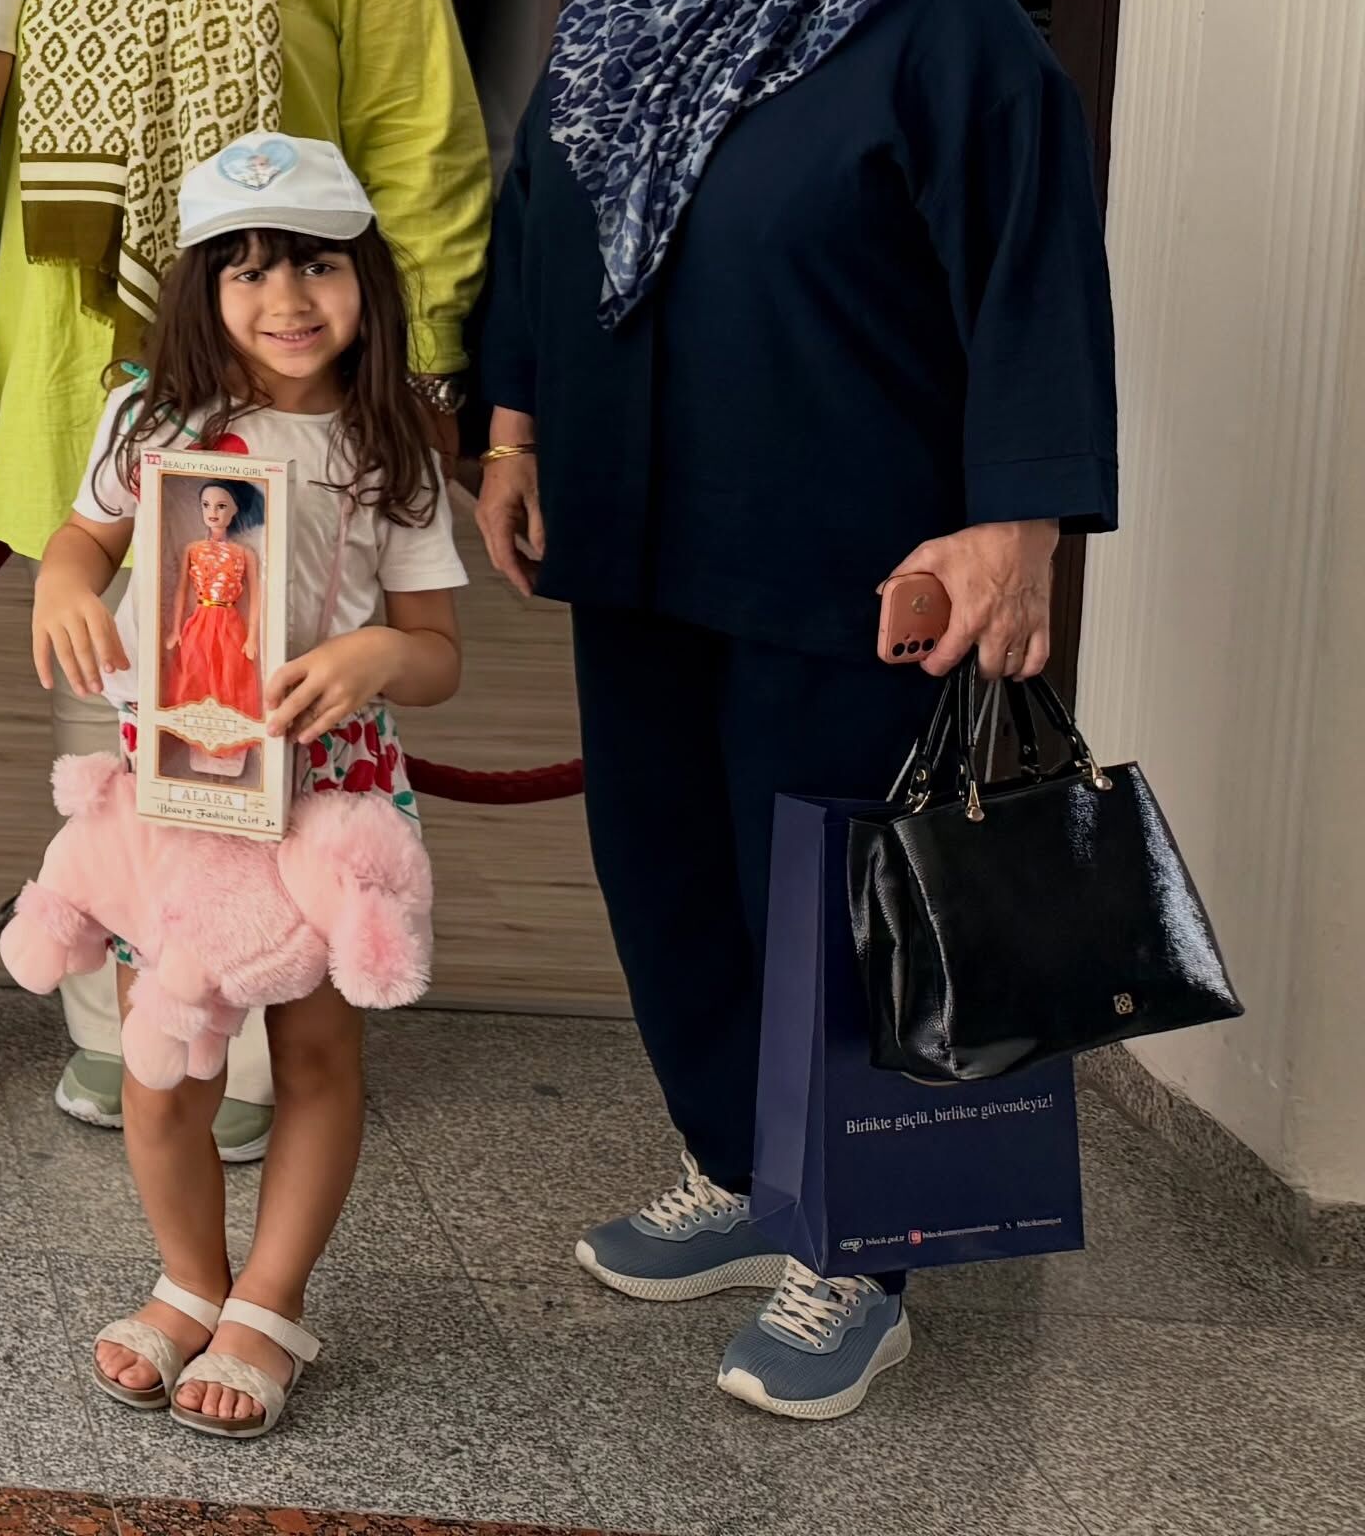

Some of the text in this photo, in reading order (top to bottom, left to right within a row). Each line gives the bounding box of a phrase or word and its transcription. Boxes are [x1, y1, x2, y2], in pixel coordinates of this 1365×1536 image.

[181, 789, 234, 806] ALARA
[846, 1094, 1053, 1134] Birlikte güçlü, birlikte güvendeyiz!
